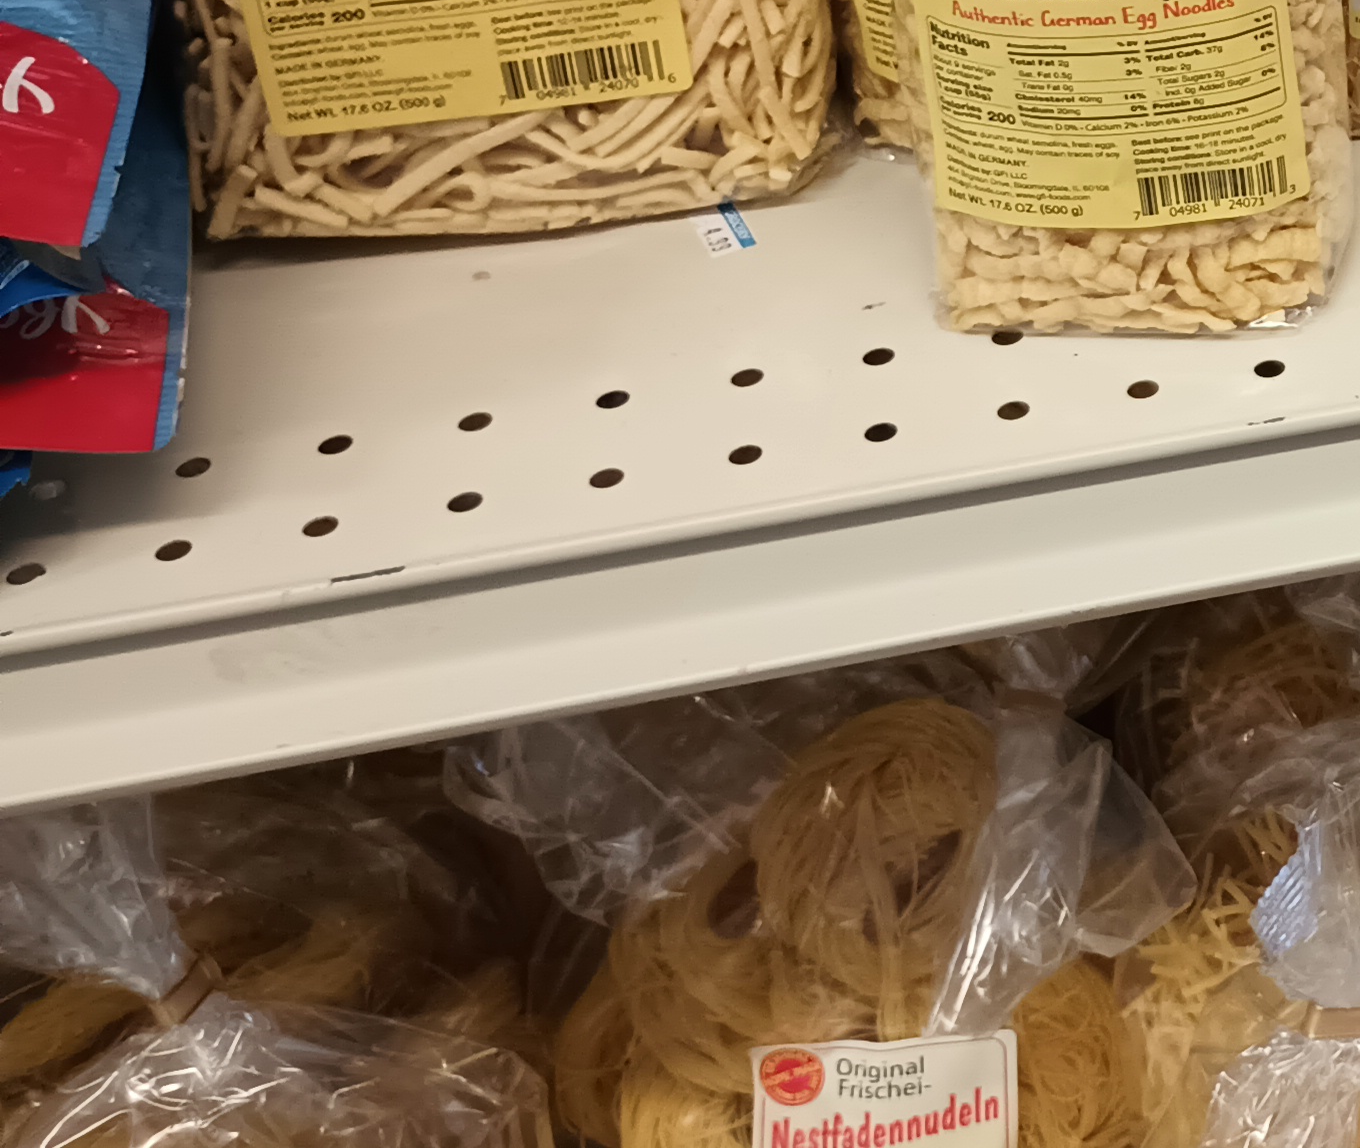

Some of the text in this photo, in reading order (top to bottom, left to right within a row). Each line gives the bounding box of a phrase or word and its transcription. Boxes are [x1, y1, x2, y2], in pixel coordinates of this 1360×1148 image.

[331, 9, 365, 23] 200
[952, 0, 1034, 27] Authentic
[1041, 10, 1116, 27] German
[1122, 6, 1157, 30] Egg
[930, 21, 990, 49] Nutrition
[931, 35, 968, 57] Facts
[668, 72, 676, 84] 6
[987, 111, 1016, 124] 200
[989, 199, 1012, 211] 17.6
[1133, 184, 1296, 221] 7 04981 24071 3
[836, 1056, 925, 1083] Original
[838, 1077, 932, 1100] Frischei-
[771, 1087, 999, 1148] Nestfadennudeln
